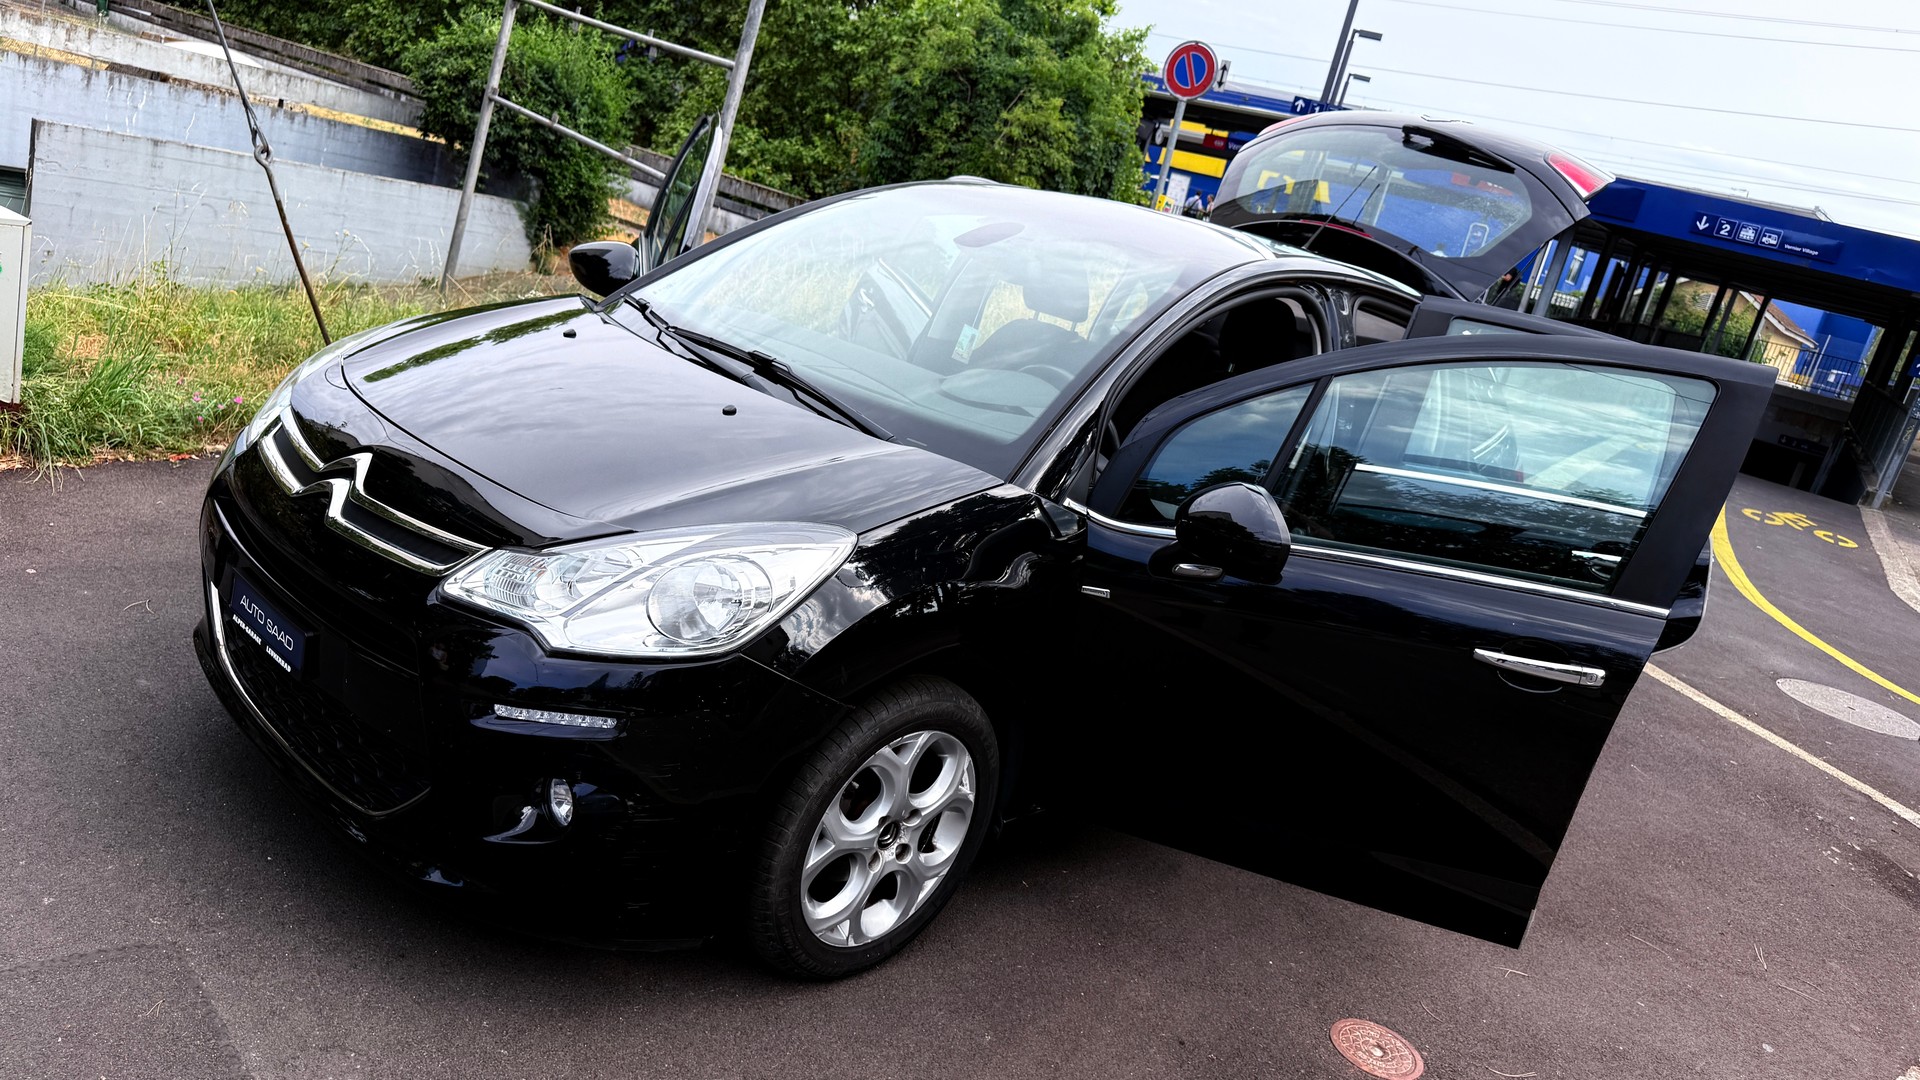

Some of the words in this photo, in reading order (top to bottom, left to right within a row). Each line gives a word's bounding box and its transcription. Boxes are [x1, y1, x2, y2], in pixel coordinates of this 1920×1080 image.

[1719, 223, 1731, 236] 2
[1784, 243, 1802, 252] Vernier
[1802, 247, 1819, 256] Village
[240, 595, 265, 624] AUTO
[266, 618, 294, 651] SAAD
